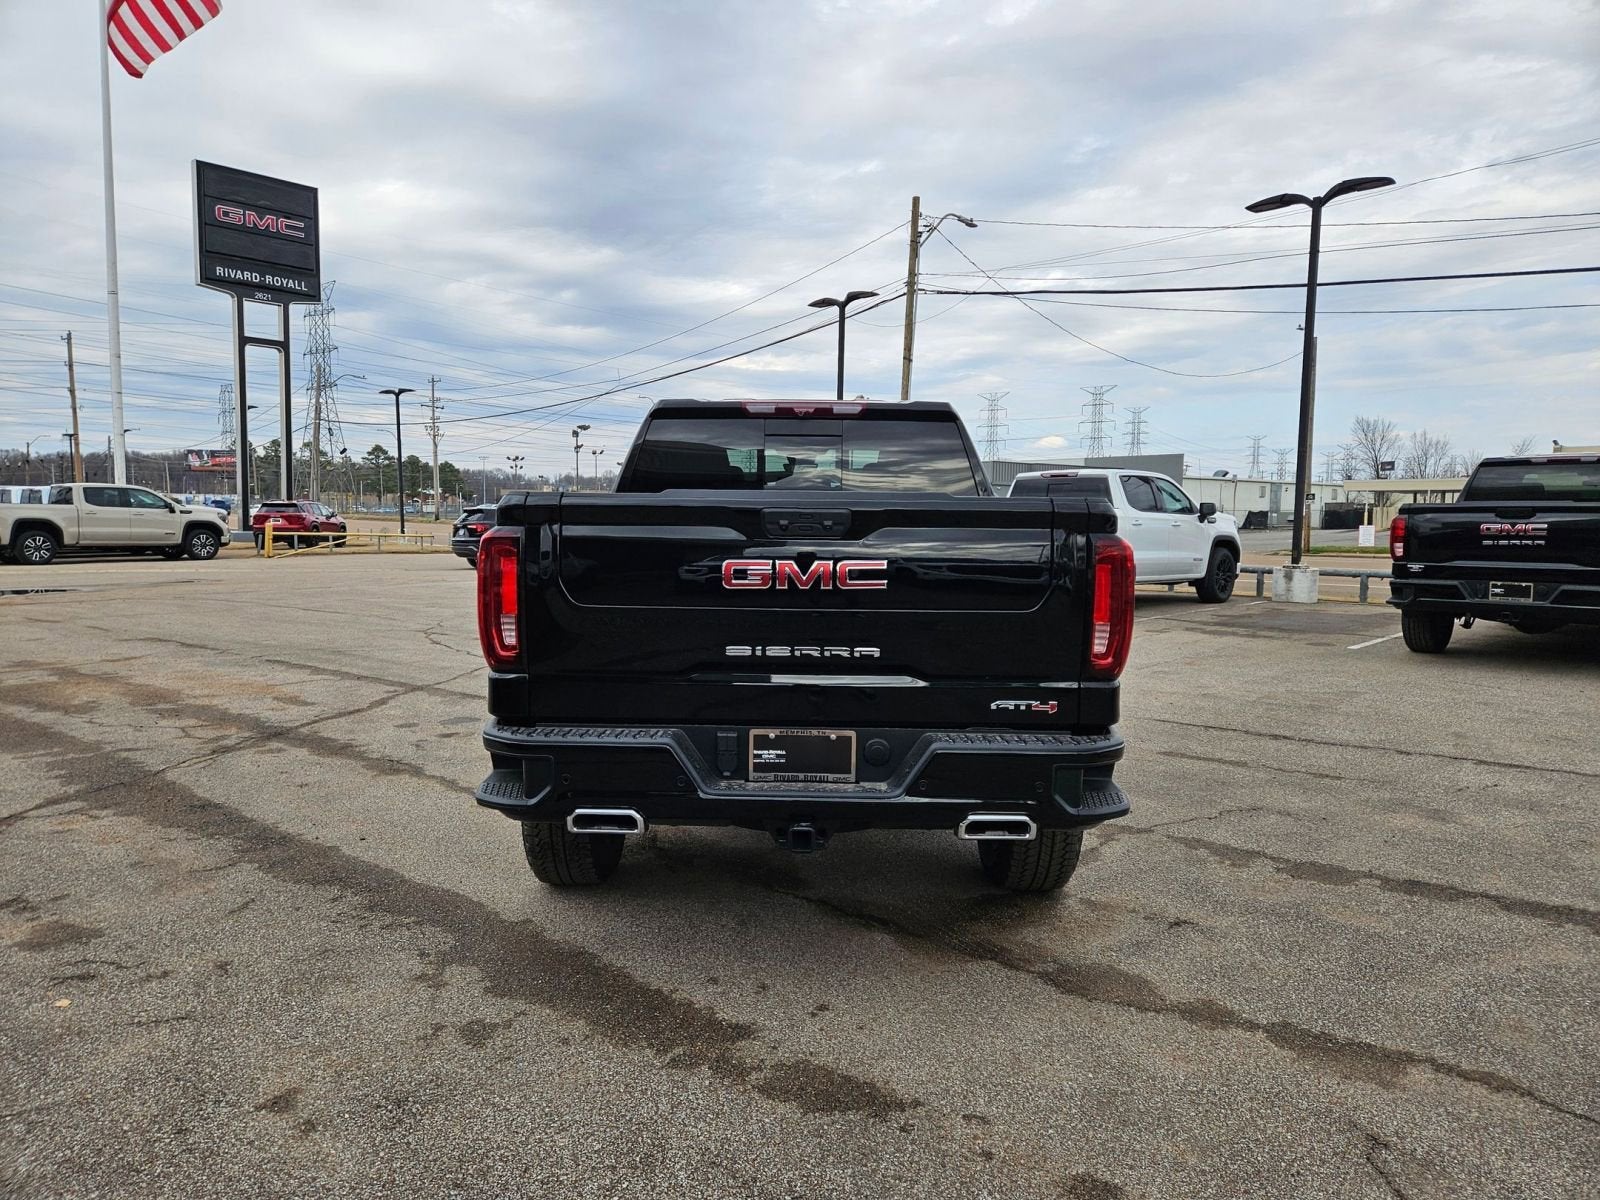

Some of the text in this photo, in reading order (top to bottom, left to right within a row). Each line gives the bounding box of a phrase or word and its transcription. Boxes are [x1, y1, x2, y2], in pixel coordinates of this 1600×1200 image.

[215, 205, 305, 238] GMC
[215, 266, 308, 291] RIVARD-ROYALL
[254, 292, 272, 301] 2621
[1480, 523, 1548, 535] GMC
[722, 559, 888, 590] GMC
[725, 645, 881, 658] SIERRA
[990, 700, 1058, 714] AT4
